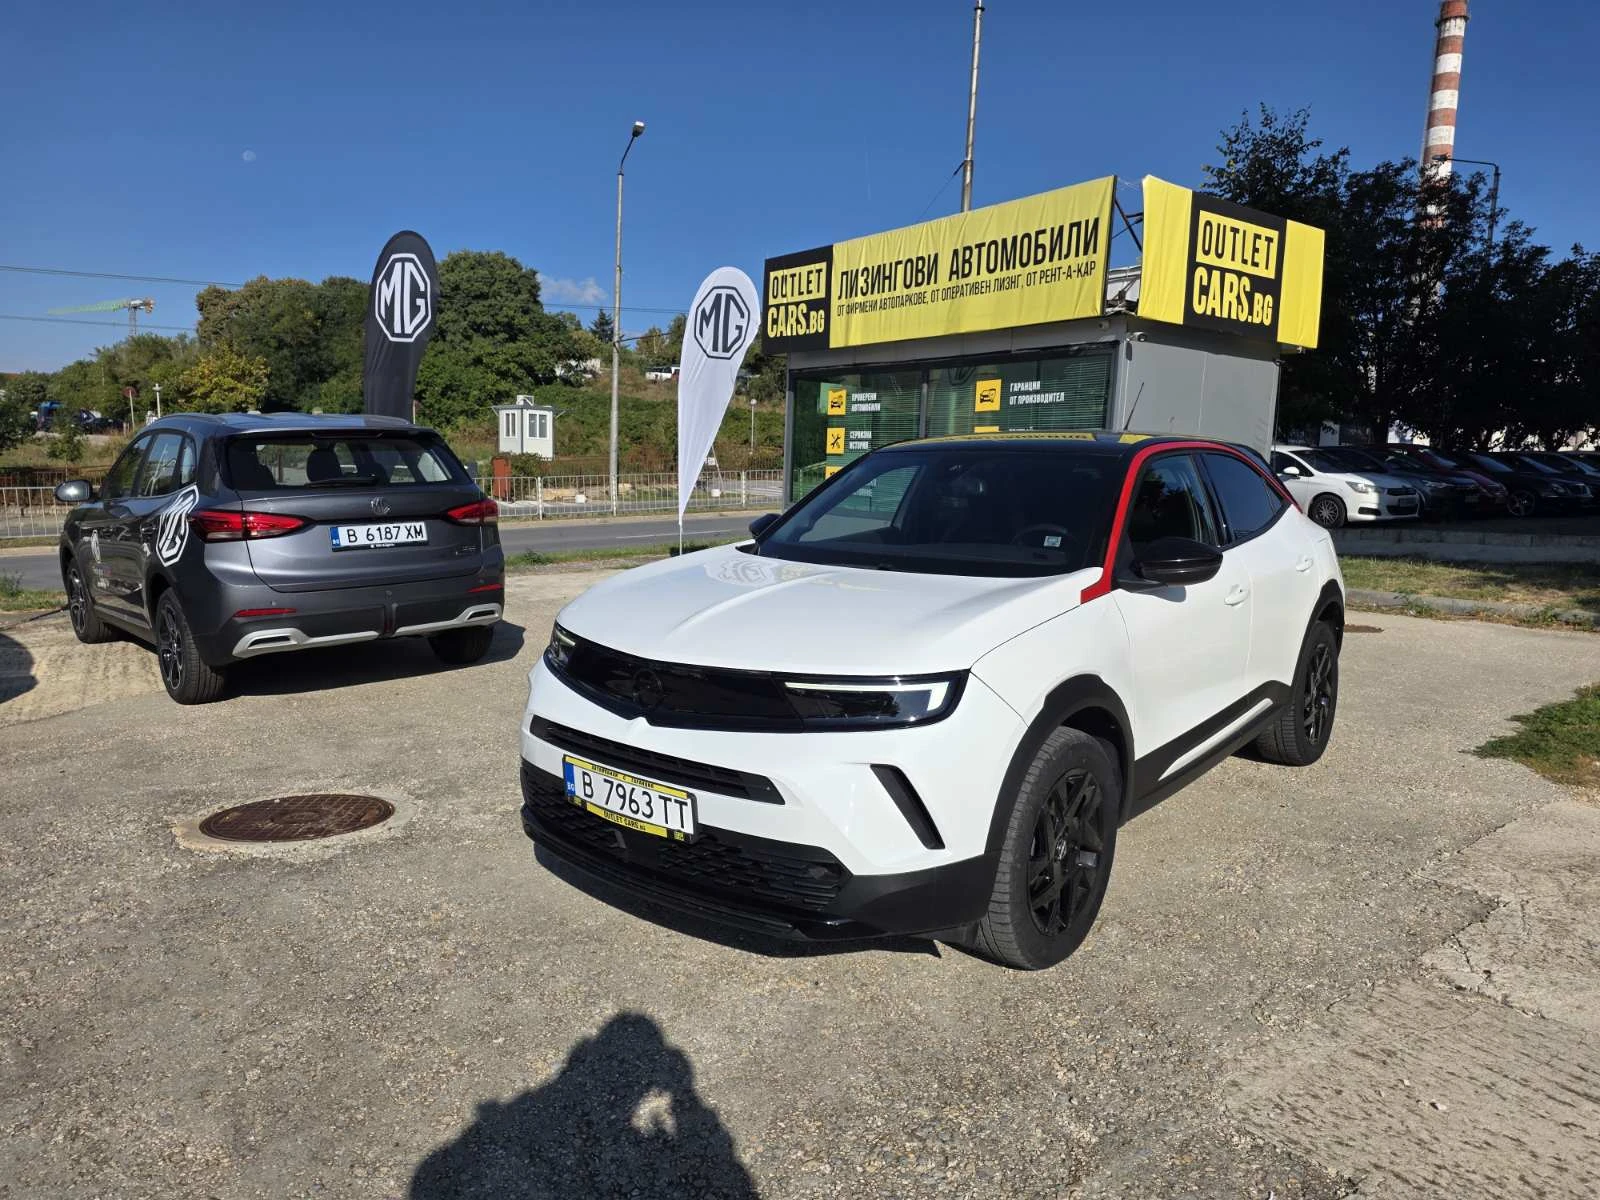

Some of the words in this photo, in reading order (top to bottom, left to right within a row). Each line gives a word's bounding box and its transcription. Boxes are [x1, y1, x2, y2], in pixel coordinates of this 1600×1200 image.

[838, 254, 938, 300] ЛИЗИНГОВИ
[948, 217, 1099, 282] АВТОМОБИЛИ
[1202, 220, 1274, 270] OUTLET
[380, 261, 426, 335] MG
[771, 268, 823, 300] OUTLET
[837, 305, 845, 317] ОТ
[845, 299, 878, 316] ФИРМЕНИ
[879, 292, 929, 311] АВТОПАРКОВЕ,
[931, 288, 940, 302] ОТ
[941, 279, 991, 302] ОПЕРАТИВЕН
[1026, 271, 1038, 287] ОТ
[1039, 260, 1096, 285] РЕНТ-А-КАР
[1193, 267, 1273, 326] CARS.BG
[699, 292, 745, 354] MG
[767, 302, 825, 339] CARS.BG
[1009, 395, 1018, 406] ОТ
[1017, 391, 1065, 405] ПРОИЗВОДИТЕЛ
[346, 528, 358, 543] B
[366, 525, 400, 542] 6187
[405, 524, 424, 540] XM
[582, 771, 594, 799] B
[603, 778, 654, 819] 7963
[658, 794, 688, 829] TT
